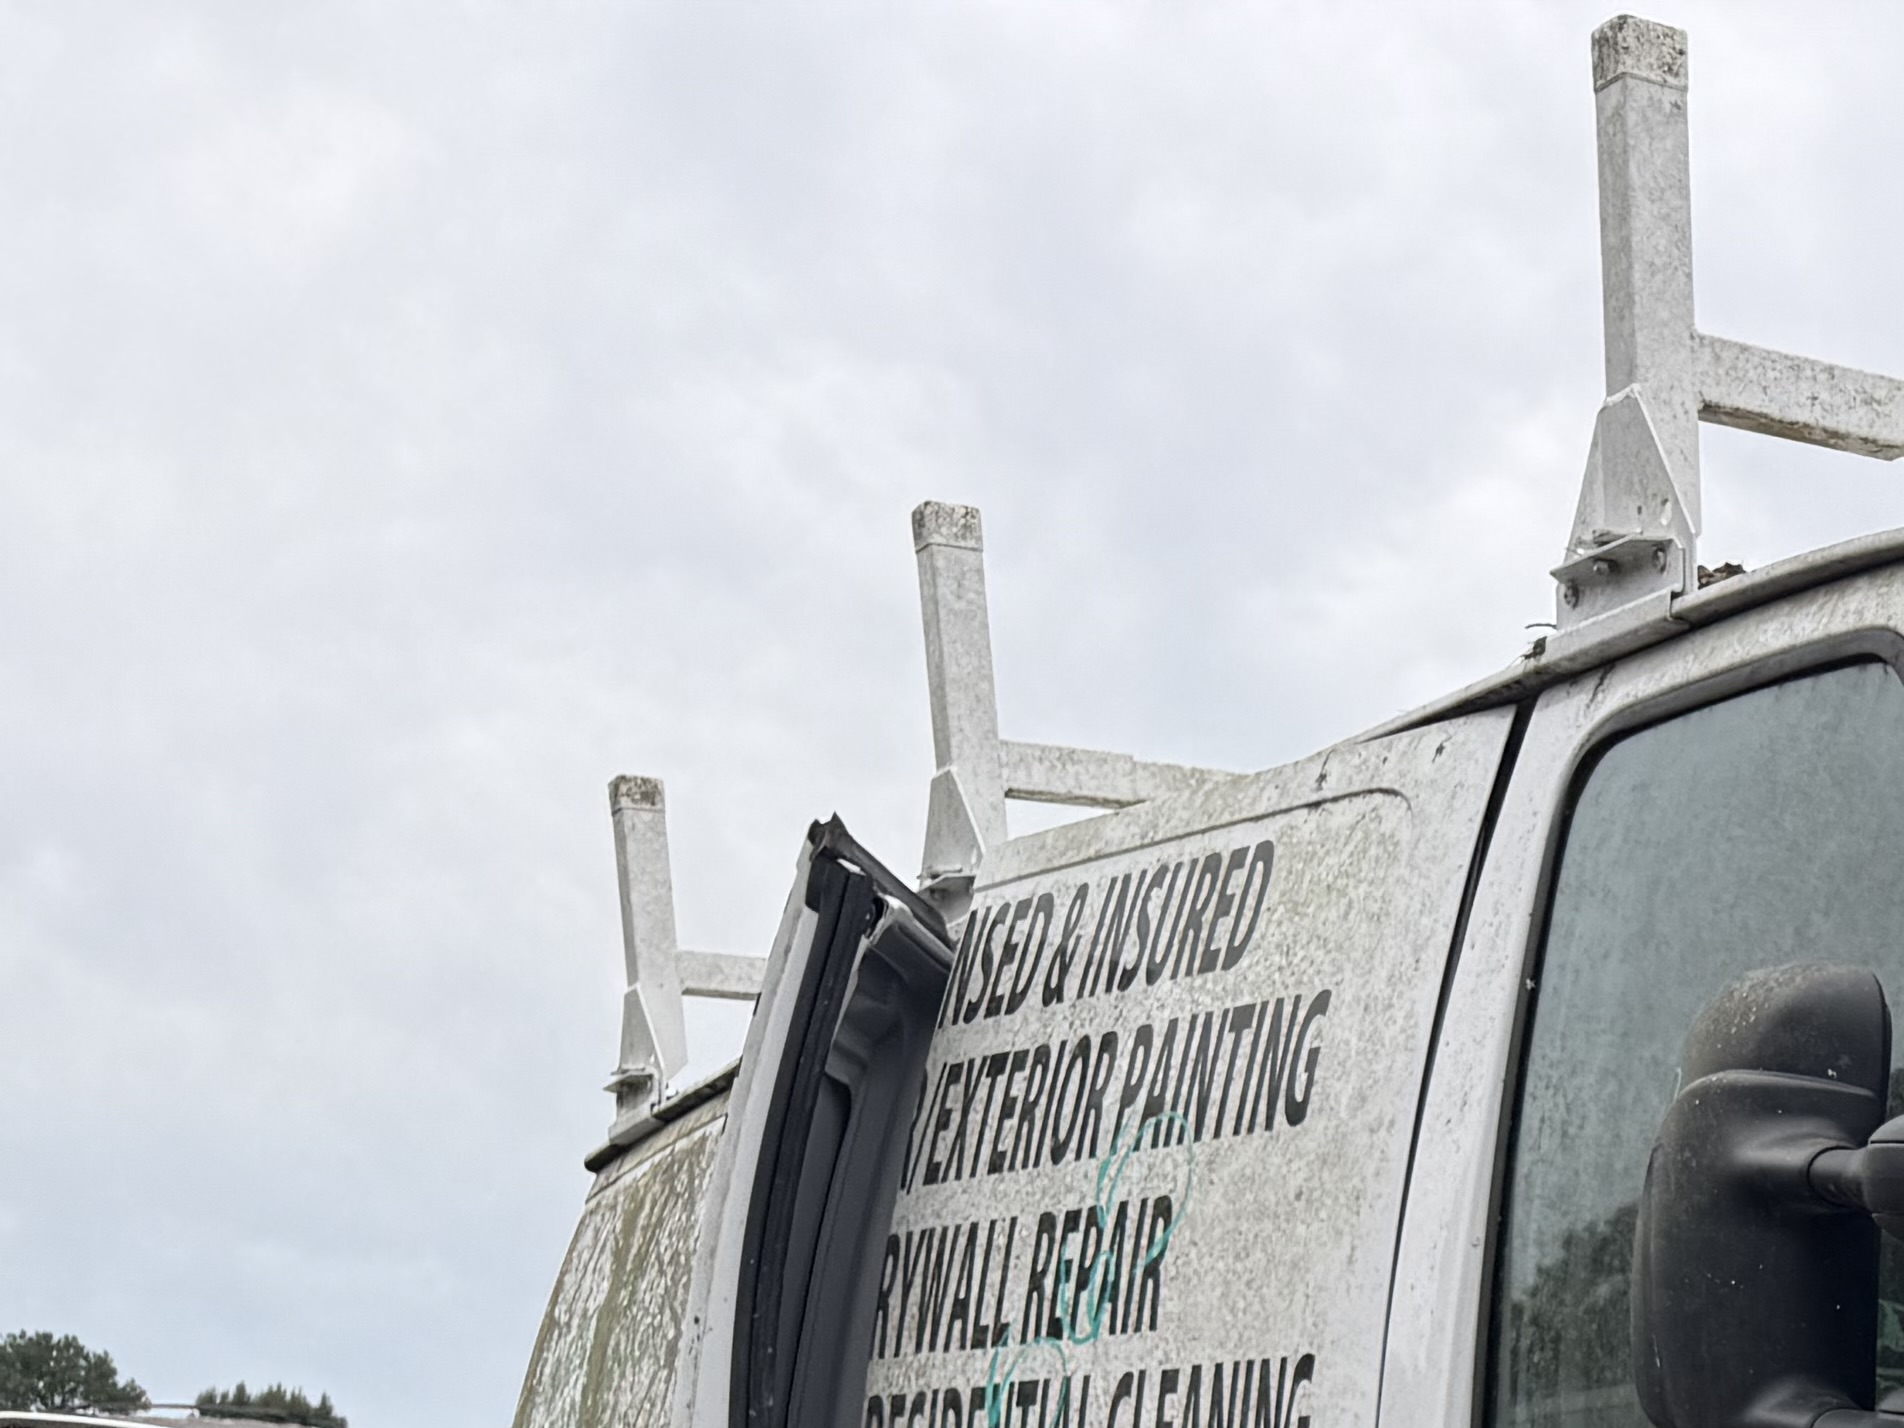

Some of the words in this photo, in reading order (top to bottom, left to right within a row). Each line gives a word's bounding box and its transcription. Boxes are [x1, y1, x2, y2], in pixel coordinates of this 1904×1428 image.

[1042, 882, 1089, 1007] &
[1077, 839, 1274, 998] INSURED
[1111, 989, 1332, 1157] PAINTING
[1020, 1195, 1173, 1344] REPAIR
